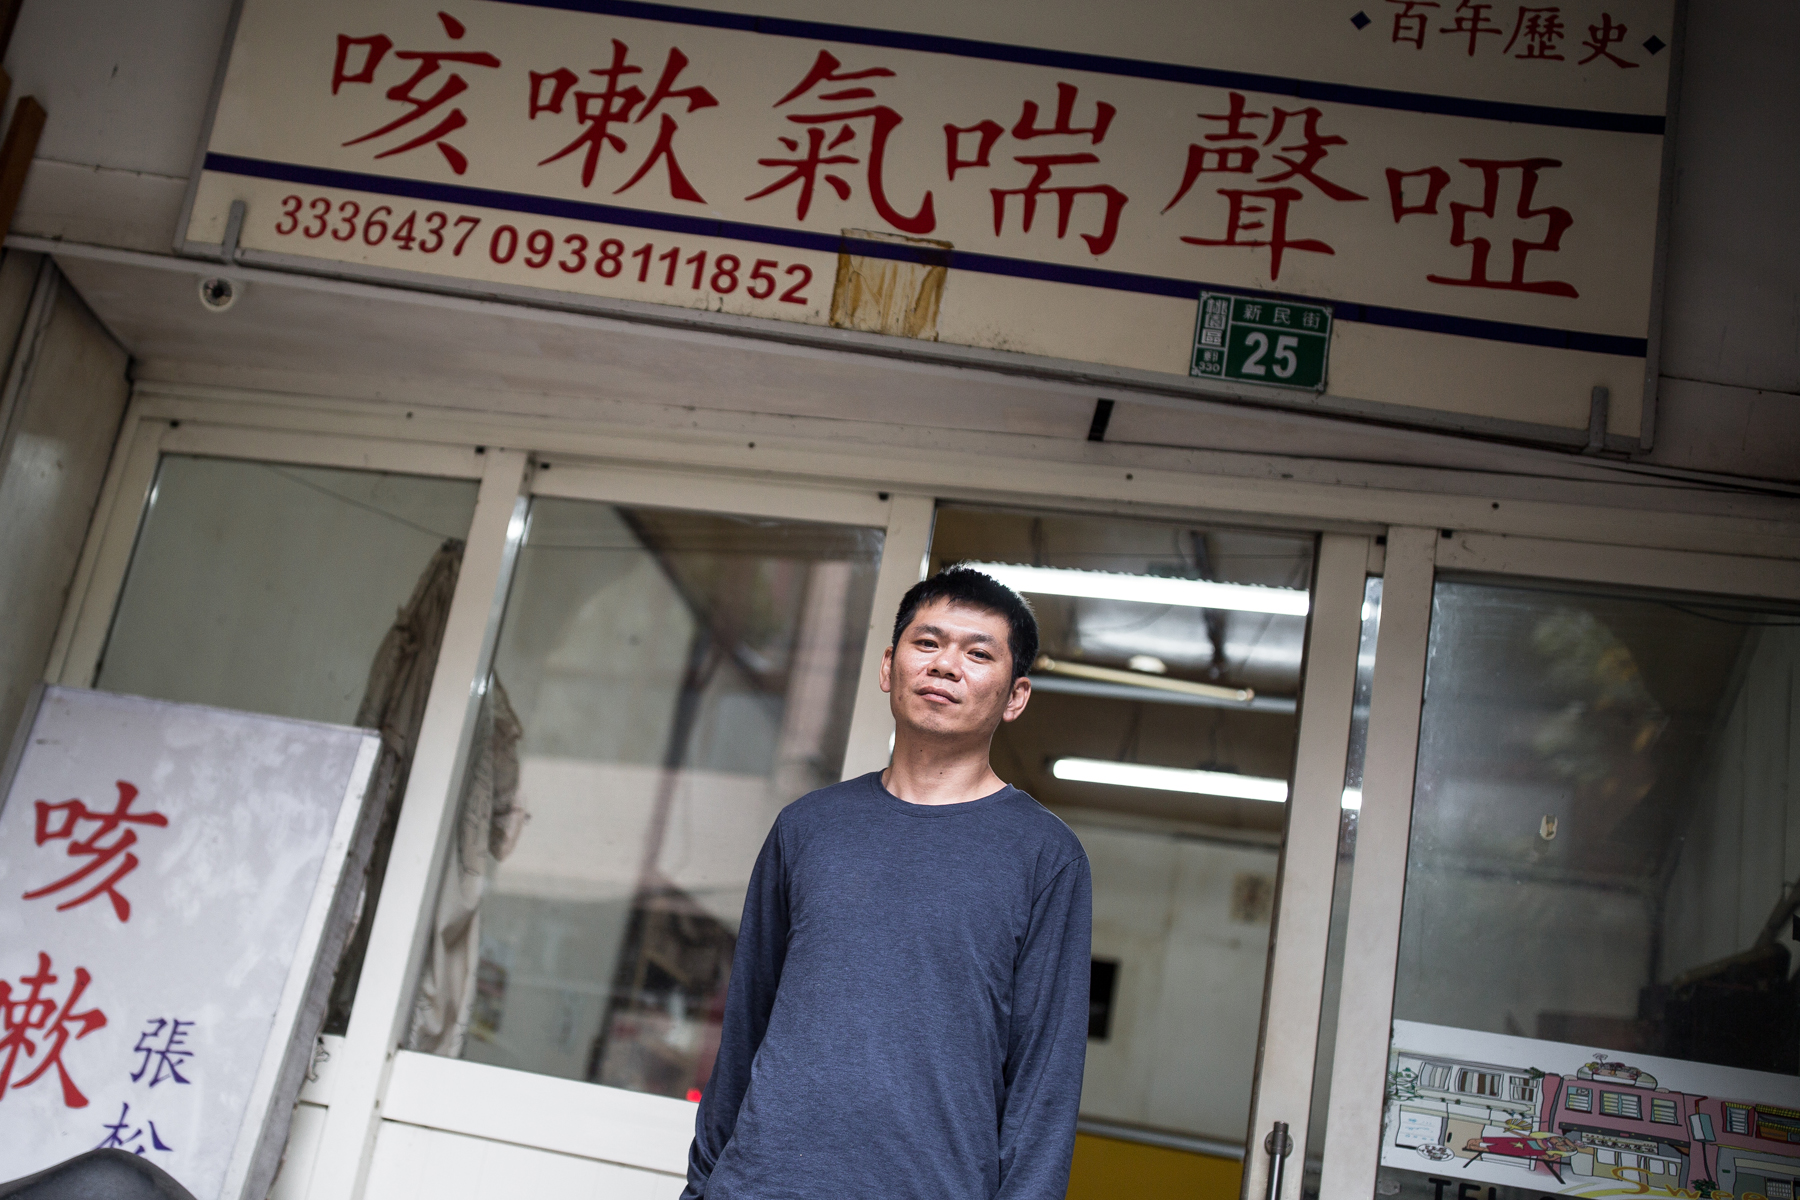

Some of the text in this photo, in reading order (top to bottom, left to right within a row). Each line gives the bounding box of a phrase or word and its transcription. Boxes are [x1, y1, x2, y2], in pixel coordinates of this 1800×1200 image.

[1386, 0, 1639, 69] 百年歷史
[332, 13, 1578, 298] 咳嗽氣喘聲啞
[275, 195, 813, 306] 3336437 0938111852
[1243, 303, 1321, 329] 新民街
[1198, 361, 1221, 373] 330
[1241, 331, 1299, 379] 25
[0, 780, 169, 1108] 咳嗽
